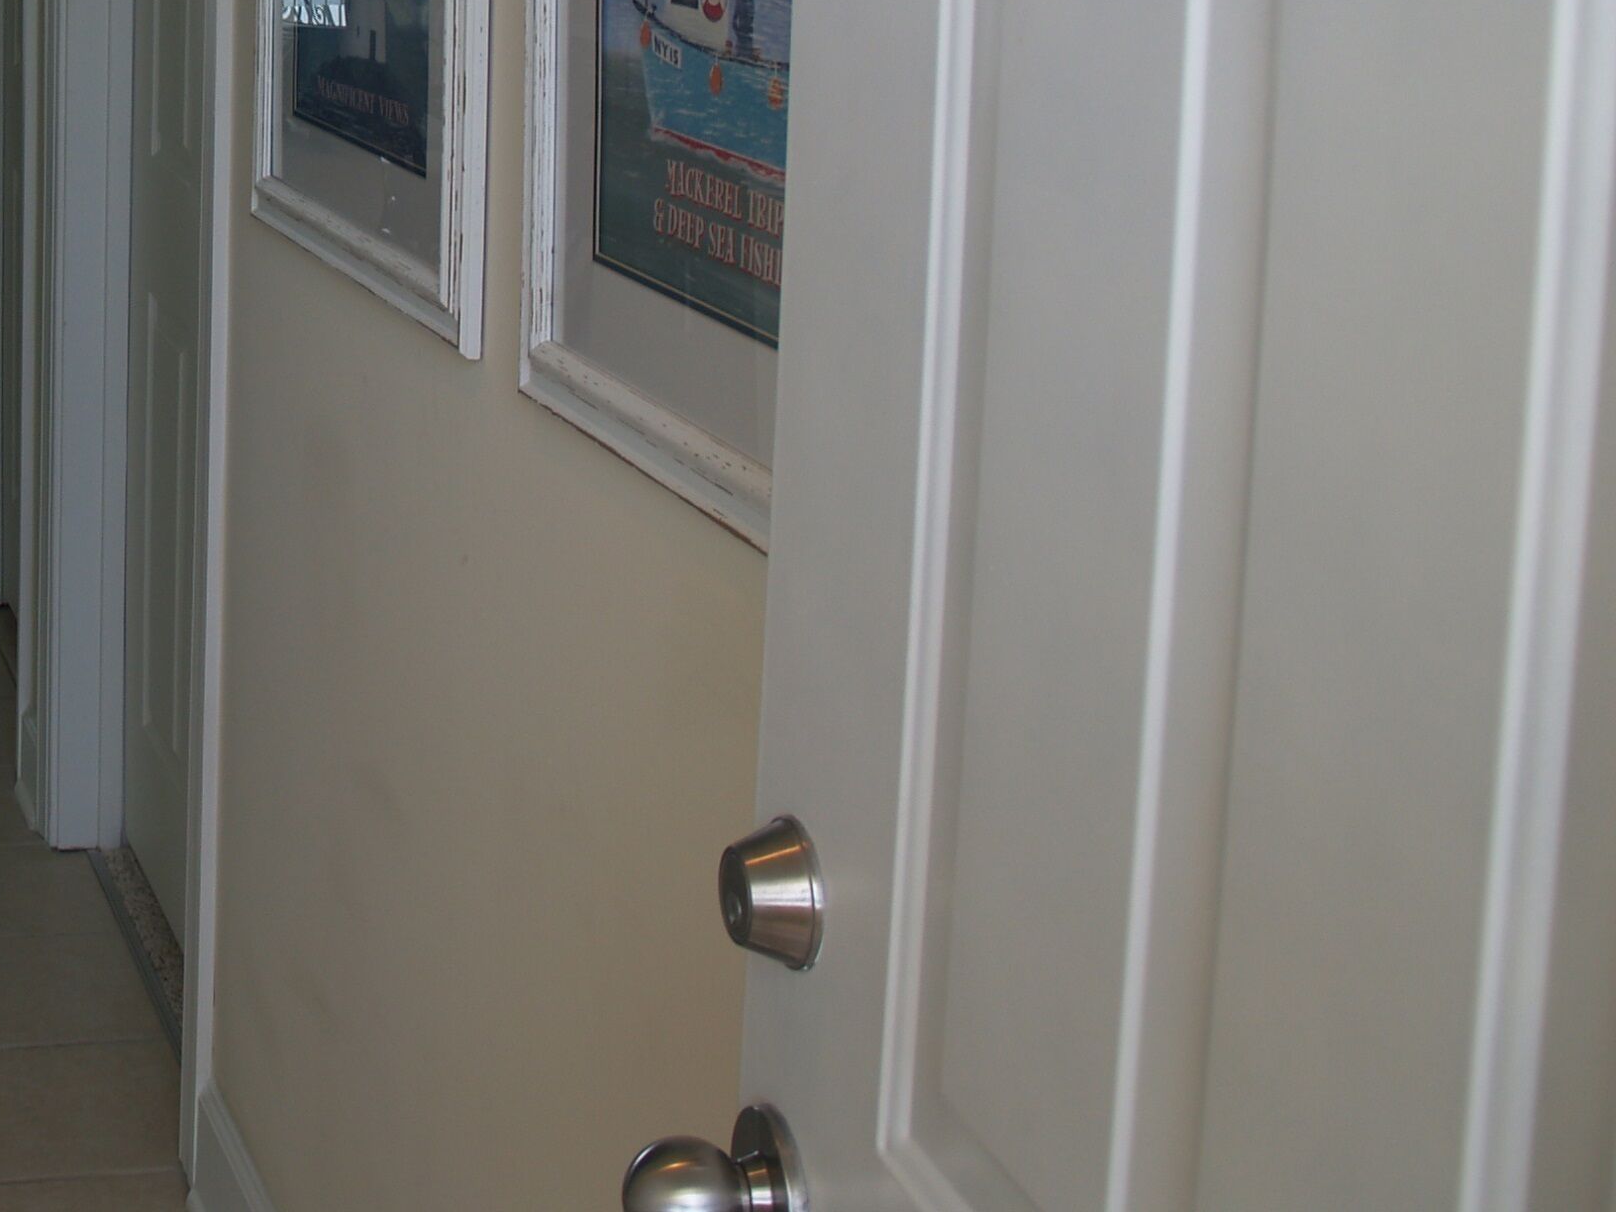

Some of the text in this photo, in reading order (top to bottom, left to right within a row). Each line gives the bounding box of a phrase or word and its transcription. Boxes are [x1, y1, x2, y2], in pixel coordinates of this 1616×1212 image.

[378, 96, 409, 126] VIEWS
[665, 158, 743, 221] MACKEREL
[653, 198, 665, 235] &
[667, 204, 705, 249] DEEP
[707, 221, 737, 265] SEA
